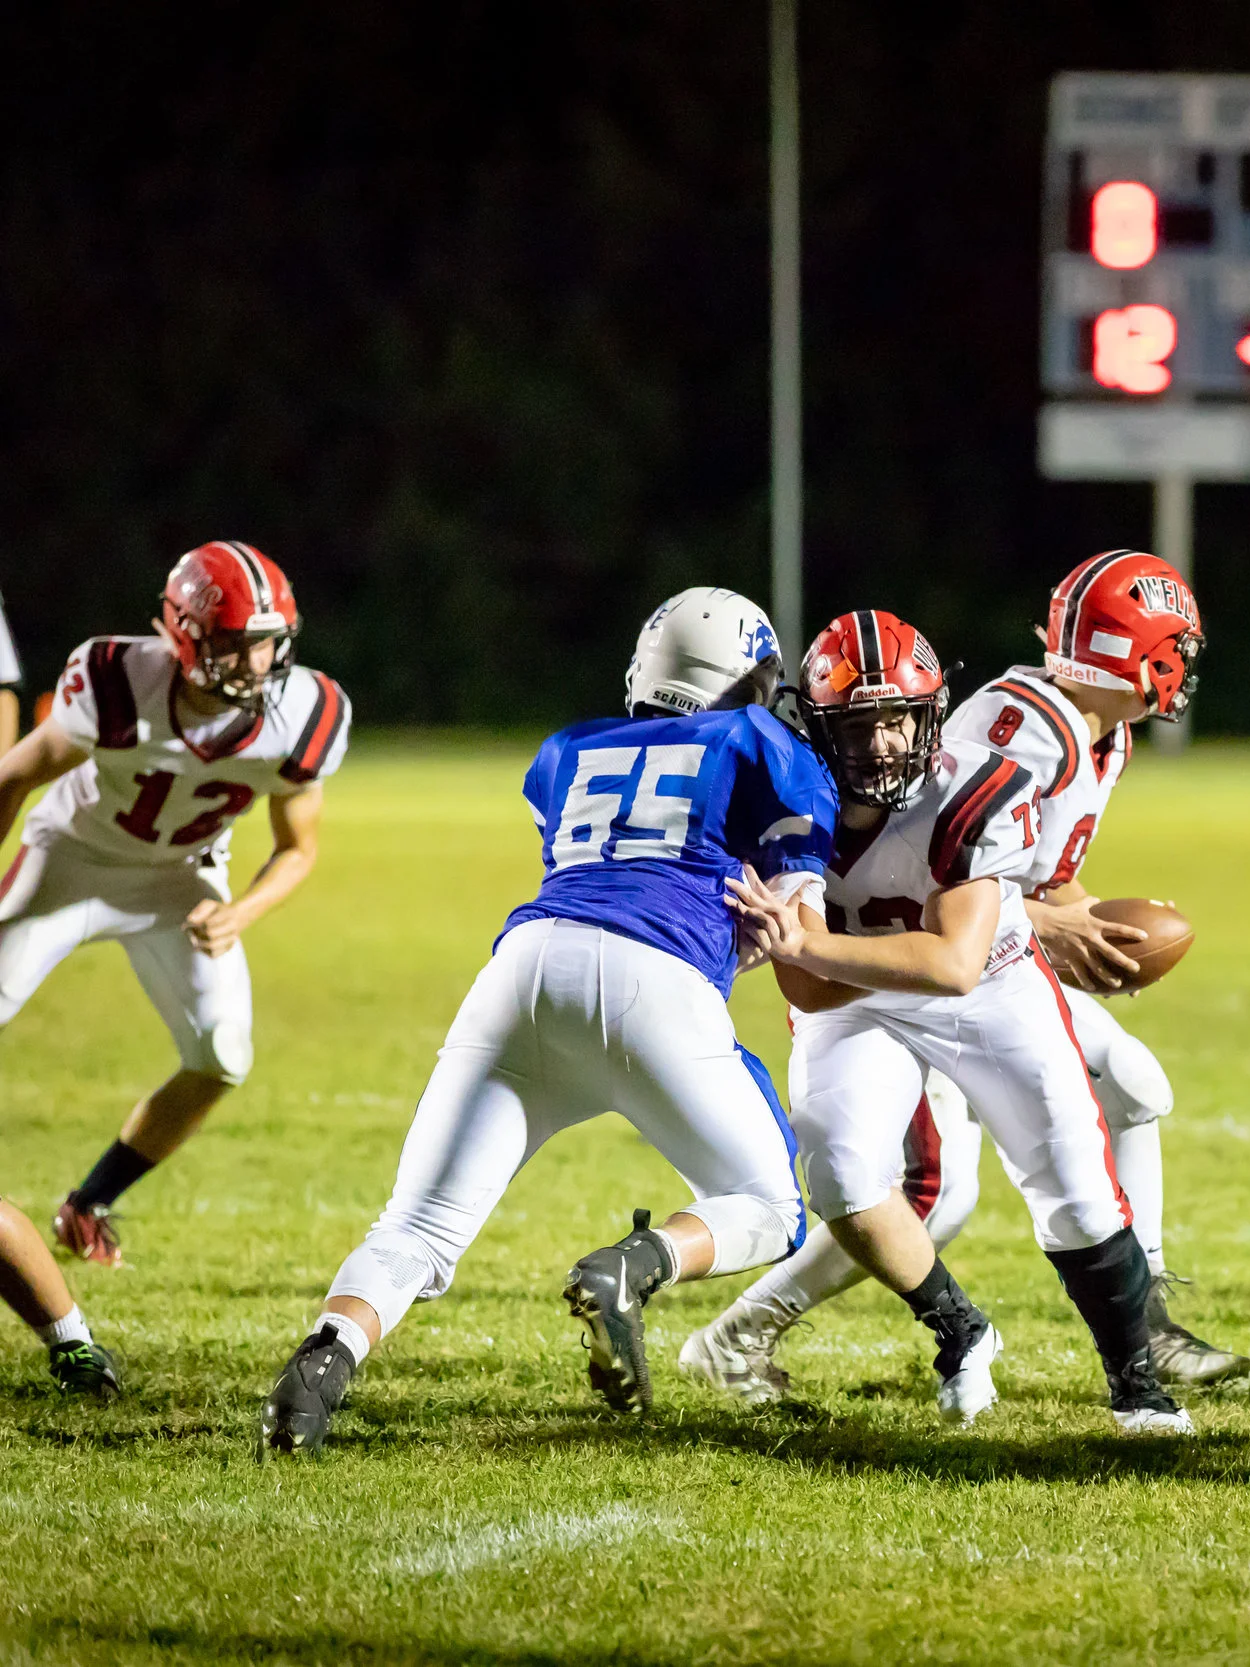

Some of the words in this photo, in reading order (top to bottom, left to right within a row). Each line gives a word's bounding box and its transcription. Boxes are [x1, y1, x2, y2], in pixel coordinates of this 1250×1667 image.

[856, 687, 896, 699] Riddell
[988, 705, 1024, 747] 8
[114, 769, 255, 847] 12
[551, 743, 708, 874] 65
